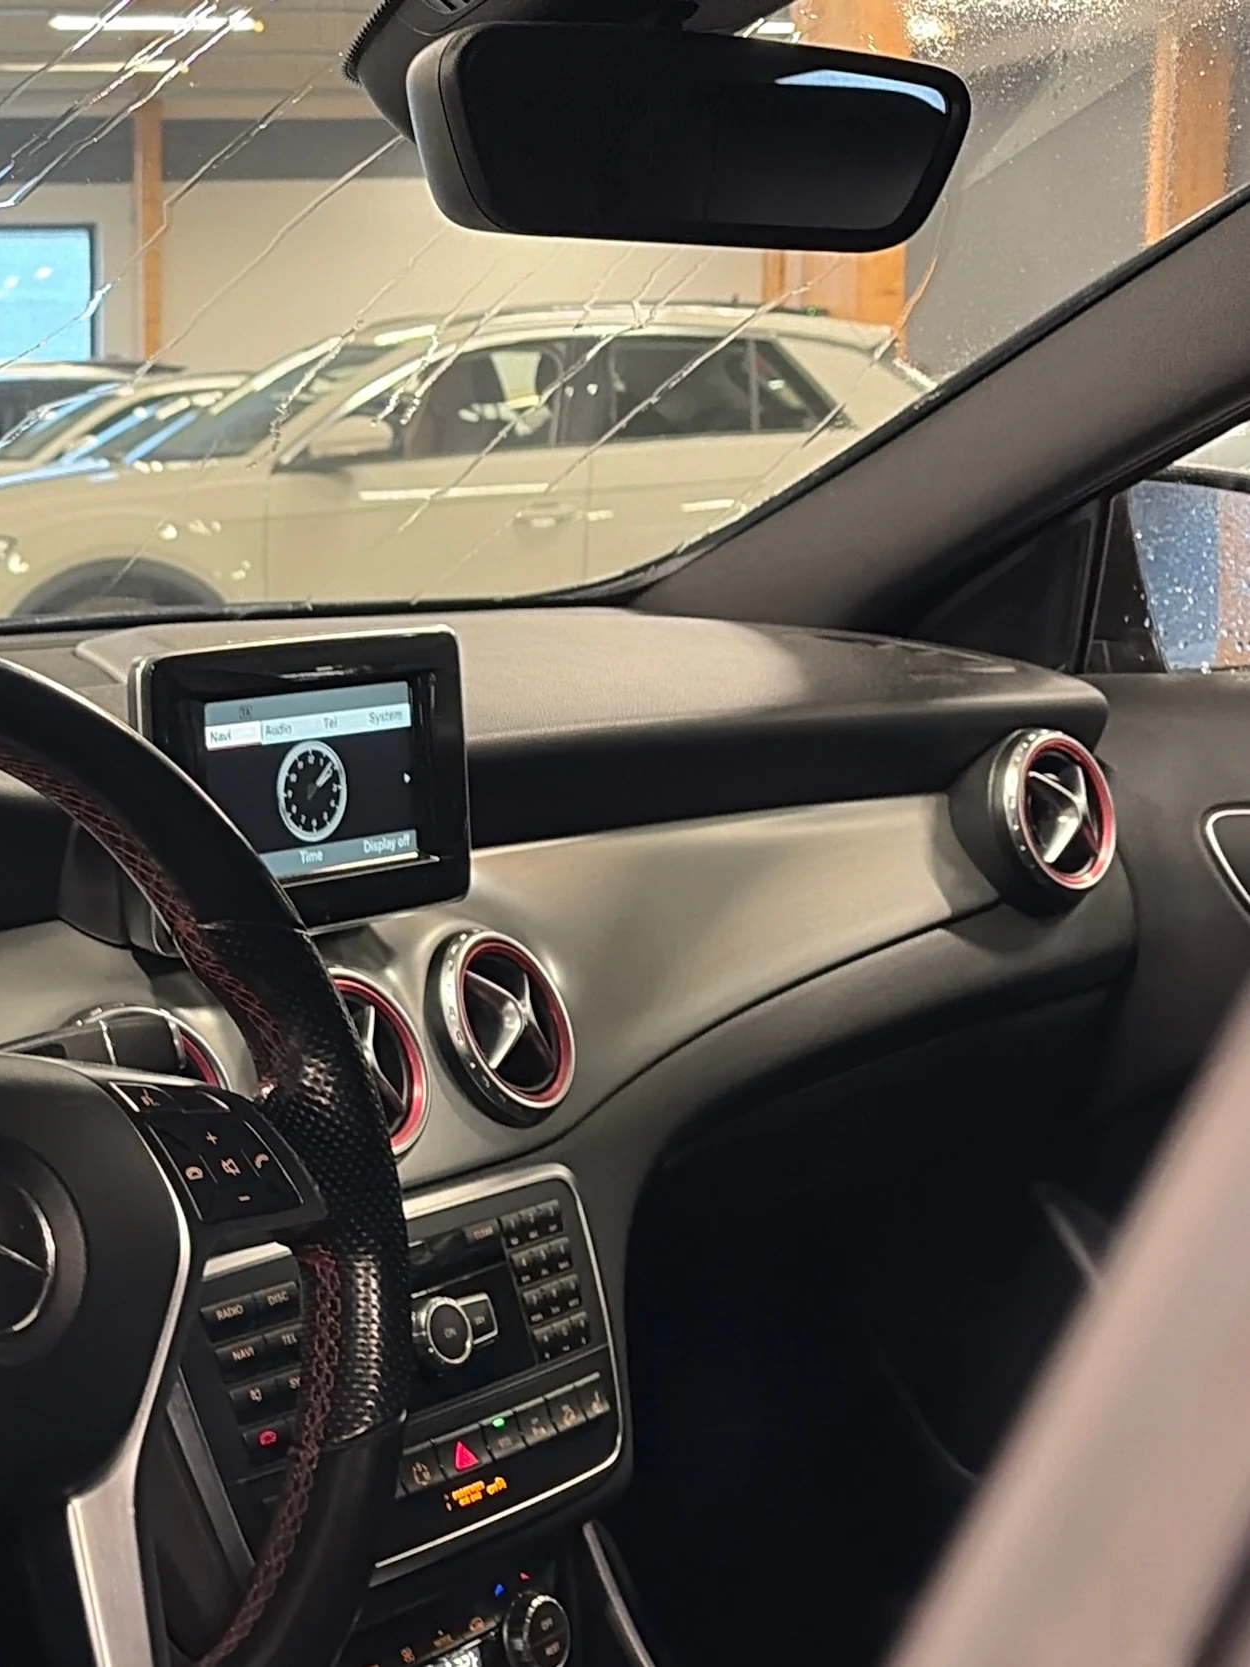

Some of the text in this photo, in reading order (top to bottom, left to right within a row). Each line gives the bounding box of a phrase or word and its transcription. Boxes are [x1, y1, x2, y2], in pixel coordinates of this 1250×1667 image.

[323, 716, 339, 730] Tel
[368, 709, 404, 725] System
[210, 731, 232, 744] Navi
[265, 723, 293, 738] Audio
[363, 833, 411, 854] Display off
[299, 850, 324, 865] Time
[267, 1290, 290, 1306] DISC
[215, 1304, 244, 1321] RADIO
[281, 1333, 298, 1346] TEL
[232, 1346, 255, 1362] NAVI
